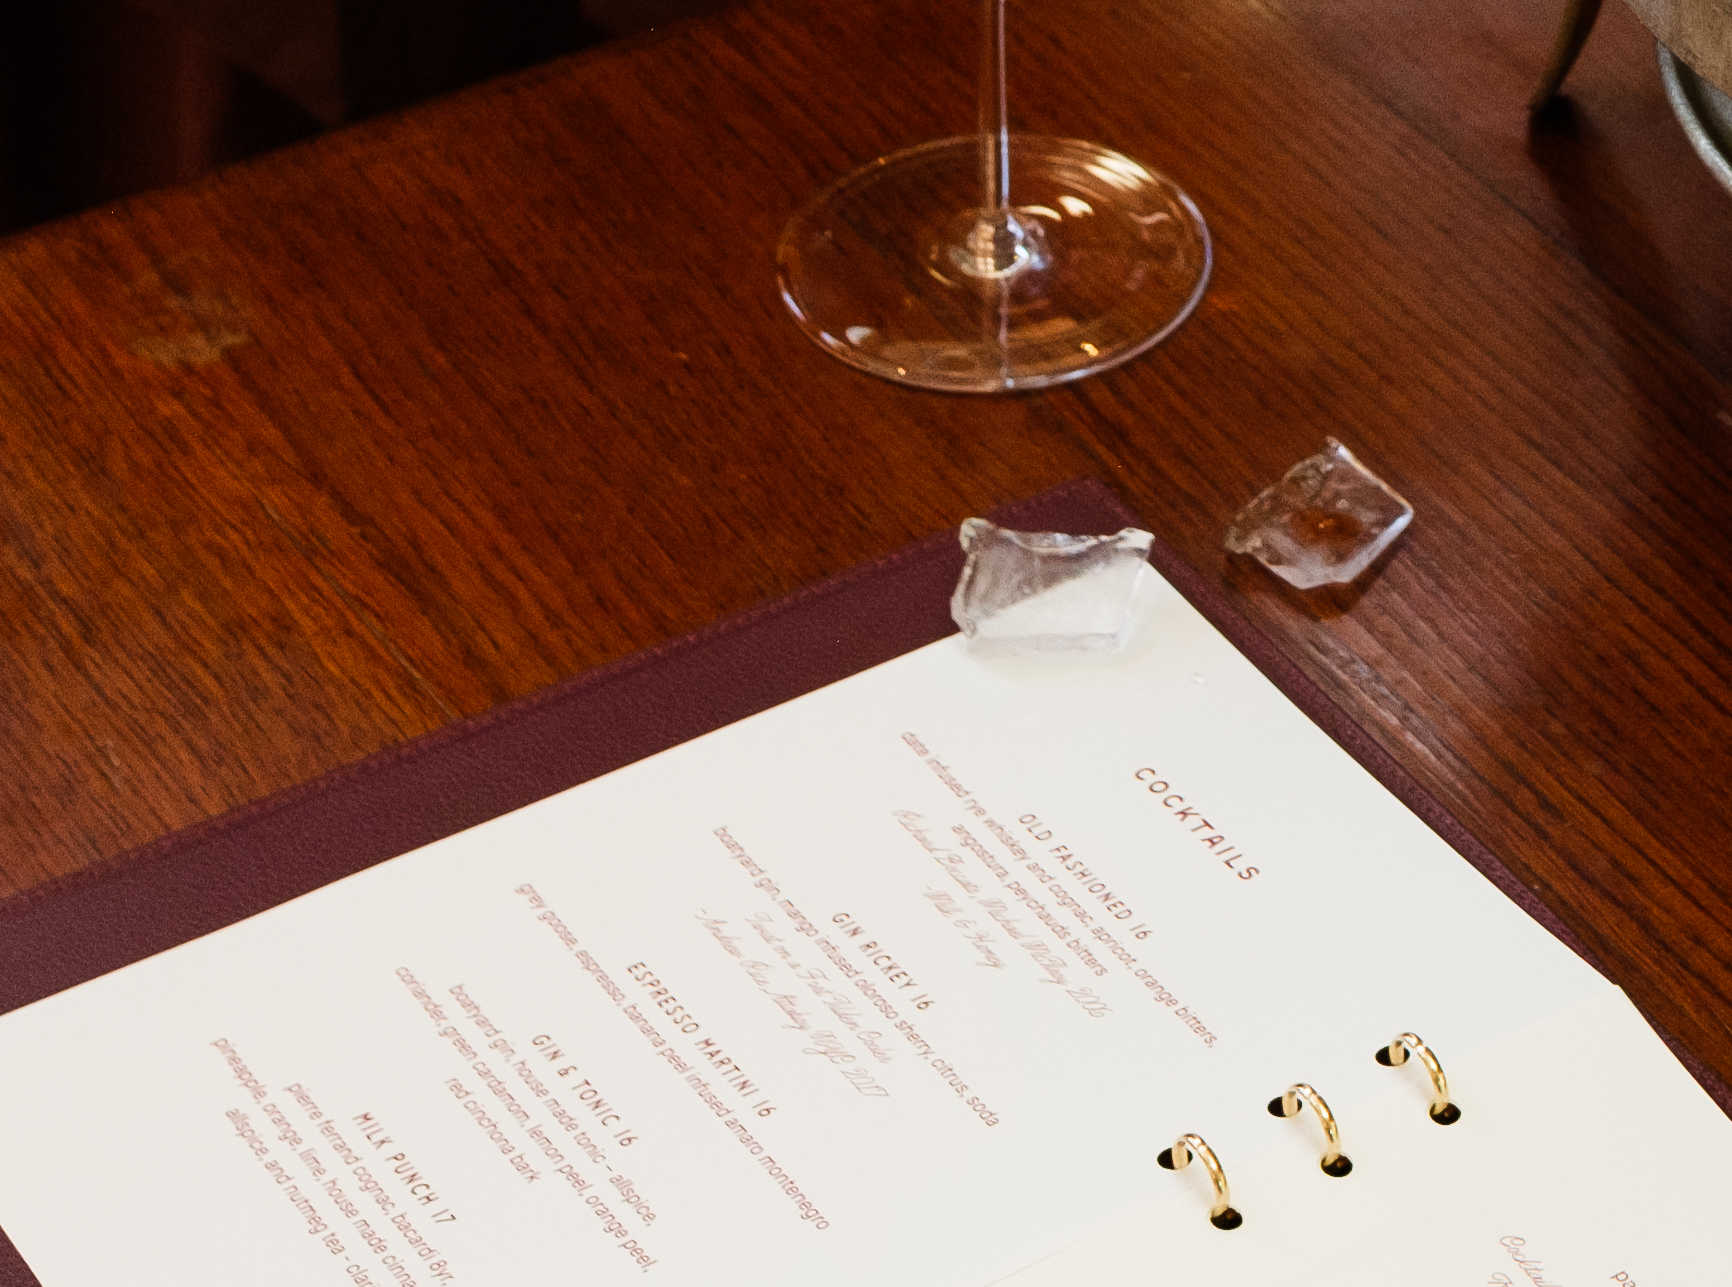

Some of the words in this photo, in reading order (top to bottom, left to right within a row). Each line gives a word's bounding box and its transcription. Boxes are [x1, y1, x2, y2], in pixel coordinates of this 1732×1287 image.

[899, 731, 930, 757] date
[924, 756, 972, 799] infused
[963, 797, 987, 817] rye
[982, 816, 1031, 861] whiskey
[1025, 861, 1056, 884] and
[1047, 883, 1094, 928] cognac,
[1089, 925, 1138, 970] apricot,
[1133, 967, 1179, 1007] orange
[1173, 1005, 1218, 1048] bitters,
[950, 823, 1010, 883] angostura,
[1002, 880, 1071, 940] peychauds
[1065, 937, 1108, 977] bitters
[1017, 813, 1053, 841] OLD
[1048, 844, 1133, 920] FASHIONED
[1128, 923, 1152, 940] 16
[1134, 767, 1260, 880] COCKTAILS
[712, 825, 767, 878] boatyard
[752, 876, 781, 901] gin,
[777, 898, 819, 937] mango
[814, 937, 863, 979] infused
[853, 977, 899, 1020] oloroso
[893, 1019, 935, 1060] sherry,
[930, 1058, 969, 1098] citrus,
[965, 1095, 1000, 1127] soda
[831, 911, 864, 937] GIN
[859, 940, 917, 989] RICKEY
[910, 993, 934, 1010] 16
[447, 982, 503, 1038] boatyard
[487, 1037, 516, 1063] gin,
[511, 1058, 549, 1098] house
[543, 1097, 579, 1132] made
[572, 1130, 607, 1164] tonic
[608, 1173, 657, 1227] allspice,
[513, 882, 548, 909] grey
[536, 909, 579, 951] goose,
[573, 948, 626, 1007] espresso,
[621, 1002, 667, 1048] banana
[655, 1046, 694, 1074] peel
[684, 1073, 734, 1118] infused
[723, 1117, 764, 1155] amaro
[757, 1154, 830, 1230] montenegro
[531, 1033, 564, 1061] GIN
[556, 1064, 578, 1077] &
[571, 1078, 621, 1126] TONIC
[613, 1128, 638, 1147] 16
[625, 961, 700, 1034] ESPRESSO
[694, 1037, 758, 1097] MARTINI
[751, 1099, 776, 1117] 16
[208, 1036, 268, 1105] pineapple,
[261, 1102, 303, 1151] orange,
[297, 1147, 327, 1182] lime,
[321, 1177, 360, 1219] house
[352, 1218, 388, 1254] made
[224, 1107, 269, 1162] allspice,
[263, 1158, 295, 1185] and
[283, 1183, 328, 1235] nutmeg
[321, 1231, 346, 1255] tea
[282, 1082, 323, 1121] pierre
[316, 1118, 363, 1166] ferrand
[351, 1165, 396, 1216] cognac,
[389, 1211, 437, 1261] bacardi
[352, 1111, 393, 1149] MILK
[385, 1151, 439, 1206] PUNCH
[430, 1208, 457, 1223] 17
[394, 966, 448, 1027] coriander,
[437, 1025, 478, 1061] green
[471, 1060, 531, 1128] cardamom,
[525, 1123, 565, 1164] lemon
[553, 1163, 593, 1197] peel,
[584, 1194, 629, 1239] orange
[617, 1238, 658, 1273] peel,
[444, 1077, 473, 1100] red
[462, 1099, 516, 1155] cinchona
[508, 1152, 540, 1183] bark
